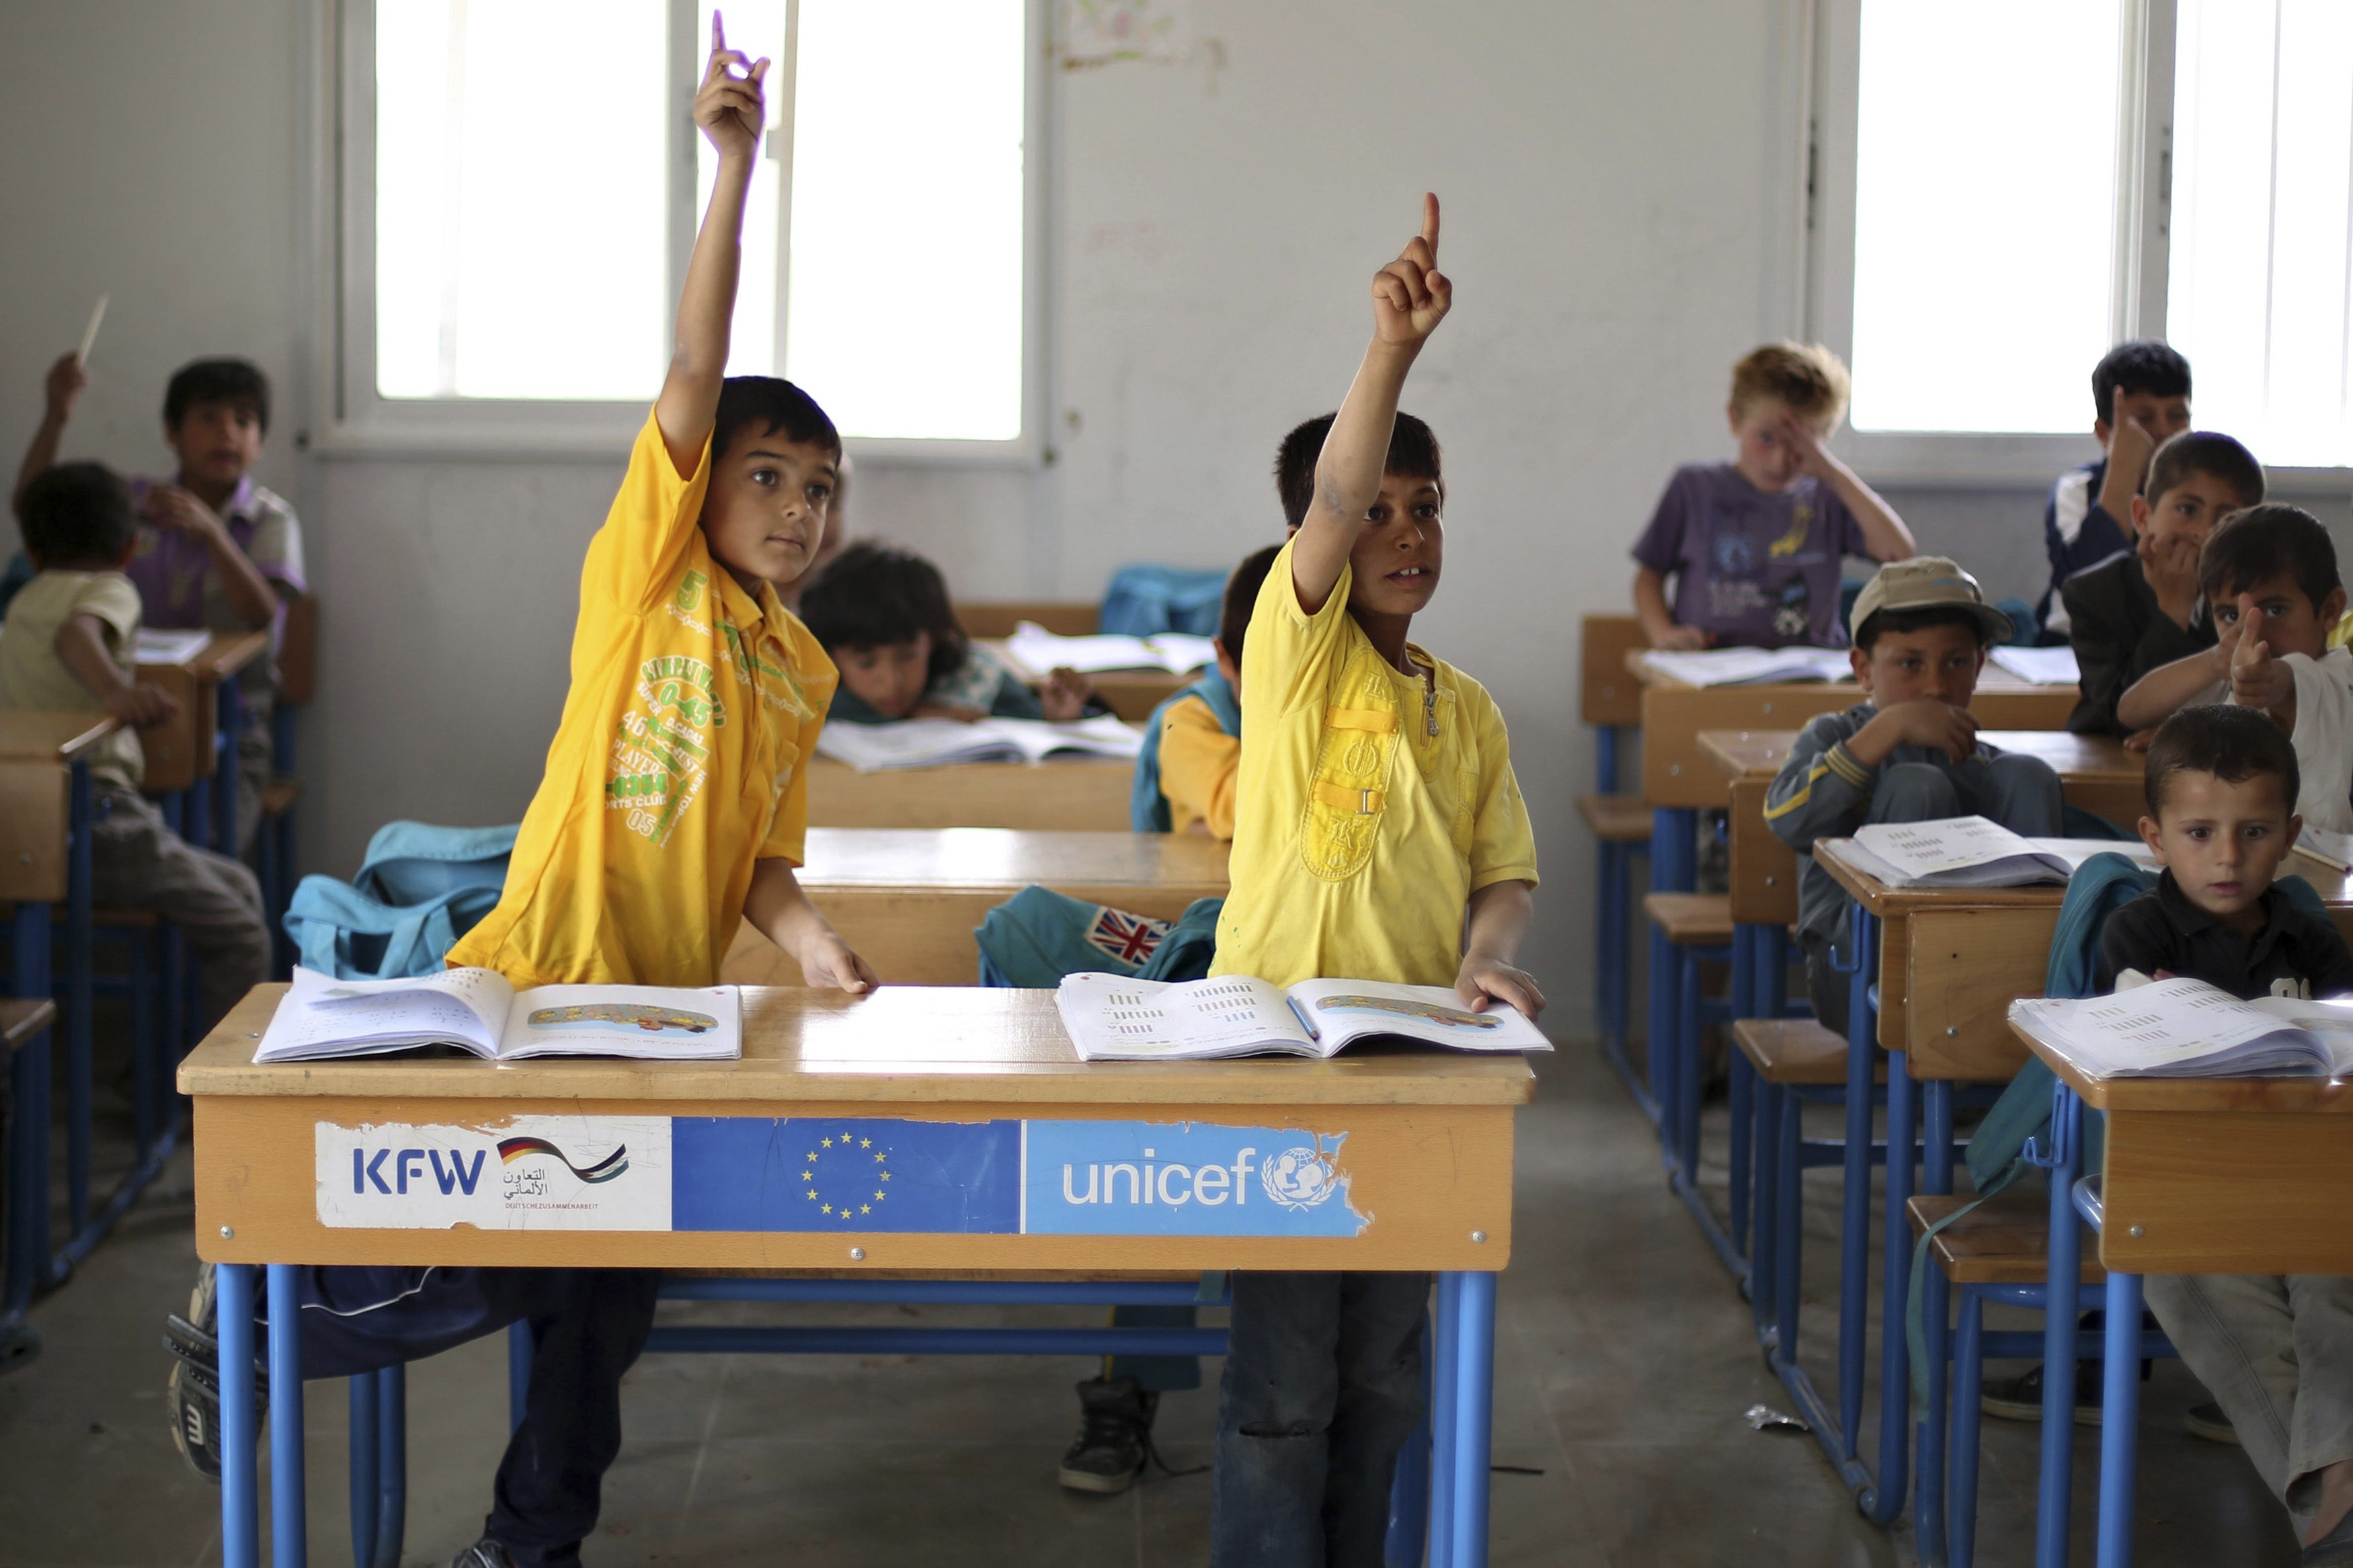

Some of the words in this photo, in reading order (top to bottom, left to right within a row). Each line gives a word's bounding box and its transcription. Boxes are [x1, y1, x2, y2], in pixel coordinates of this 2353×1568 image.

[676, 568, 709, 613] 5
[637, 681, 663, 716] SUPER
[623, 710, 649, 737] 46
[626, 808, 657, 837] 05
[353, 1148, 487, 1196] KFW
[503, 1168, 545, 1184] التعاون
[1063, 1148, 1256, 1206] unicef
[504, 1181, 548, 1200] الألماني
